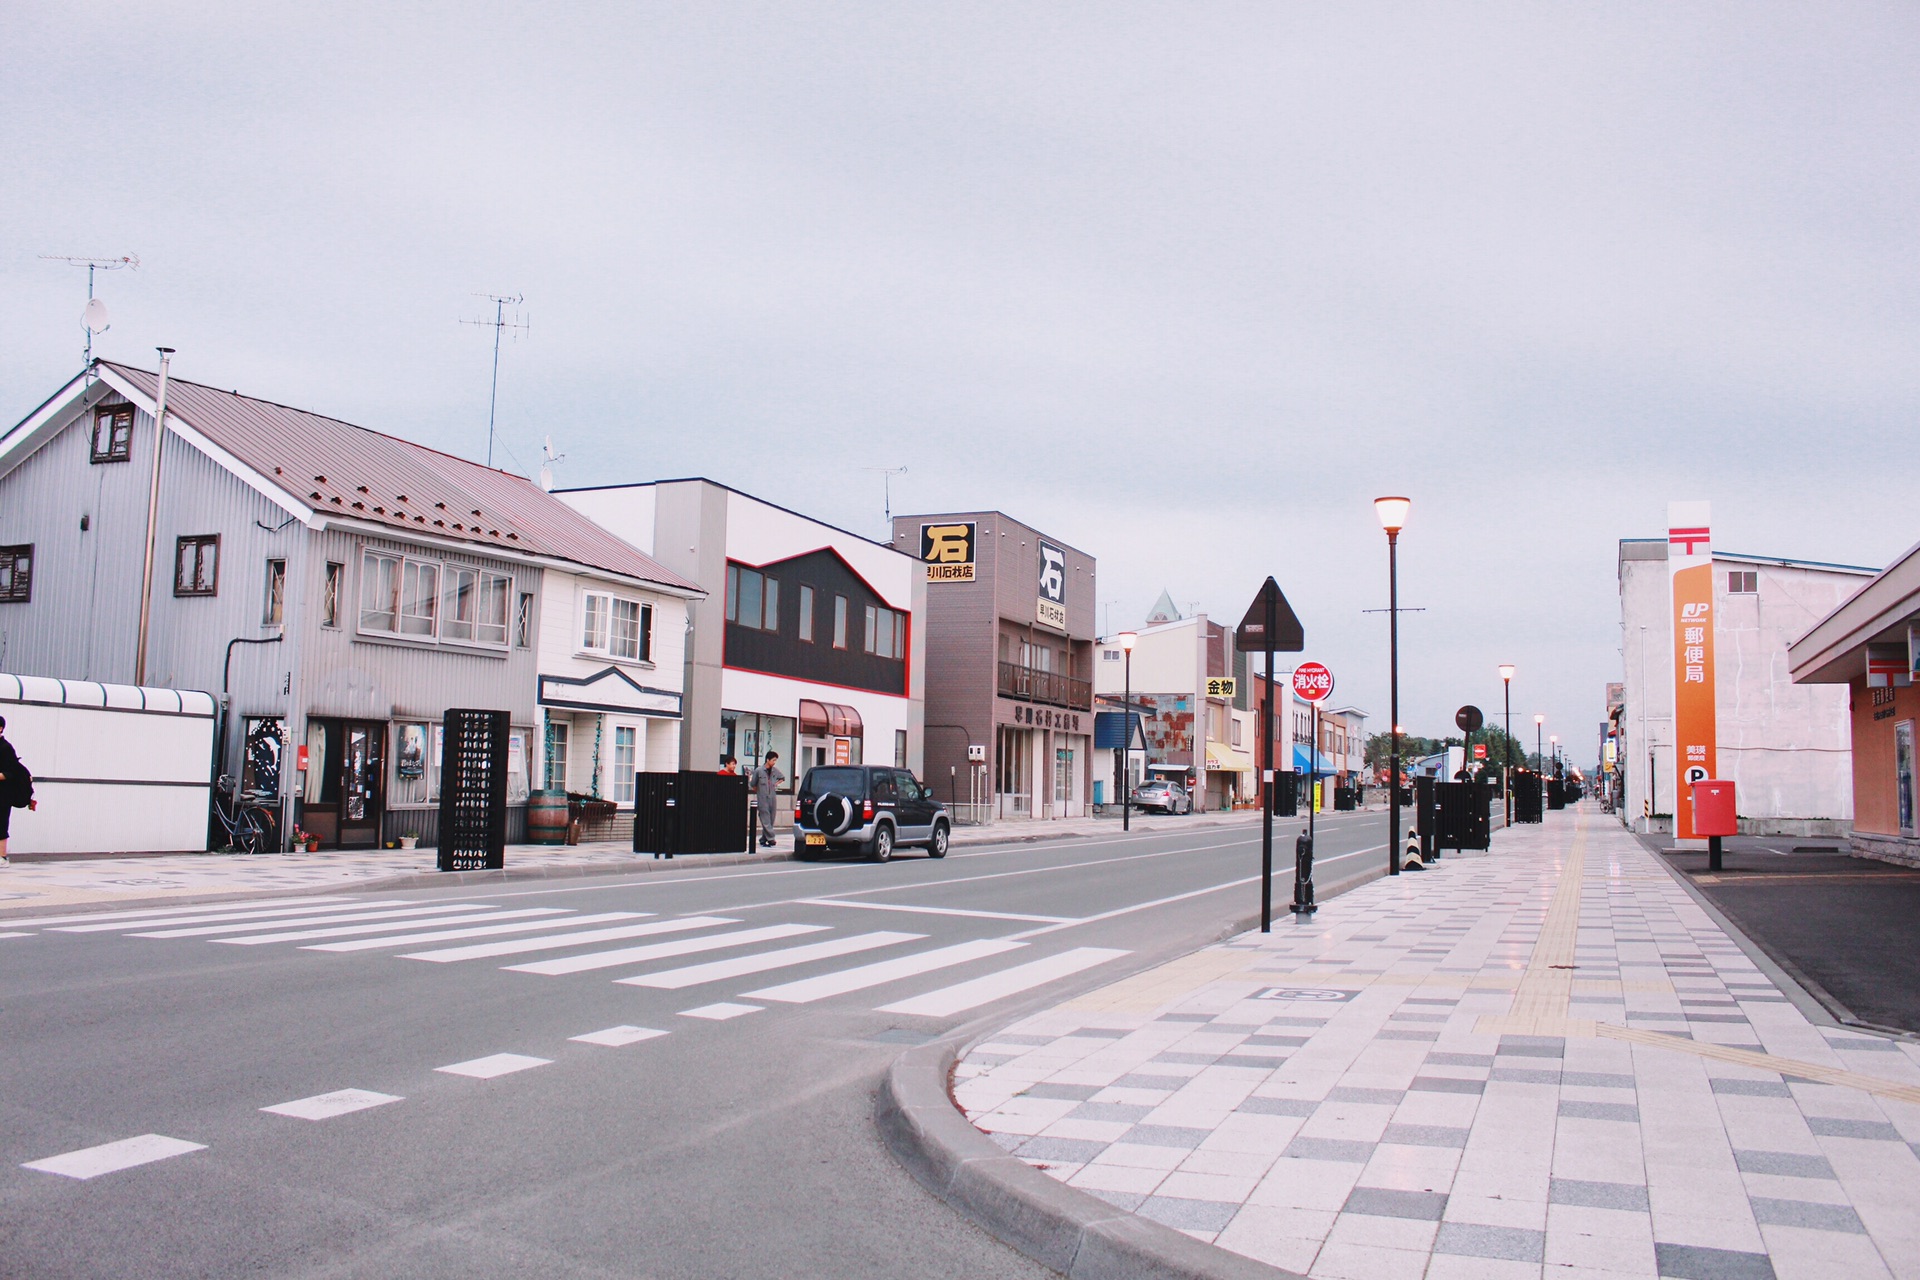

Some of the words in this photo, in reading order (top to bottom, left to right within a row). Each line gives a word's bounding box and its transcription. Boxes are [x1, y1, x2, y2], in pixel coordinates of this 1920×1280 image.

[925, 525, 968, 562] 石
[1040, 546, 1064, 600] 石
[1684, 627, 1704, 683] 郵便局
[1208, 679, 1233, 694] 金物
[1294, 673, 1329, 689] 消火栓
[1686, 745, 1706, 755] 美瑛
[1691, 769, 1704, 782] P
